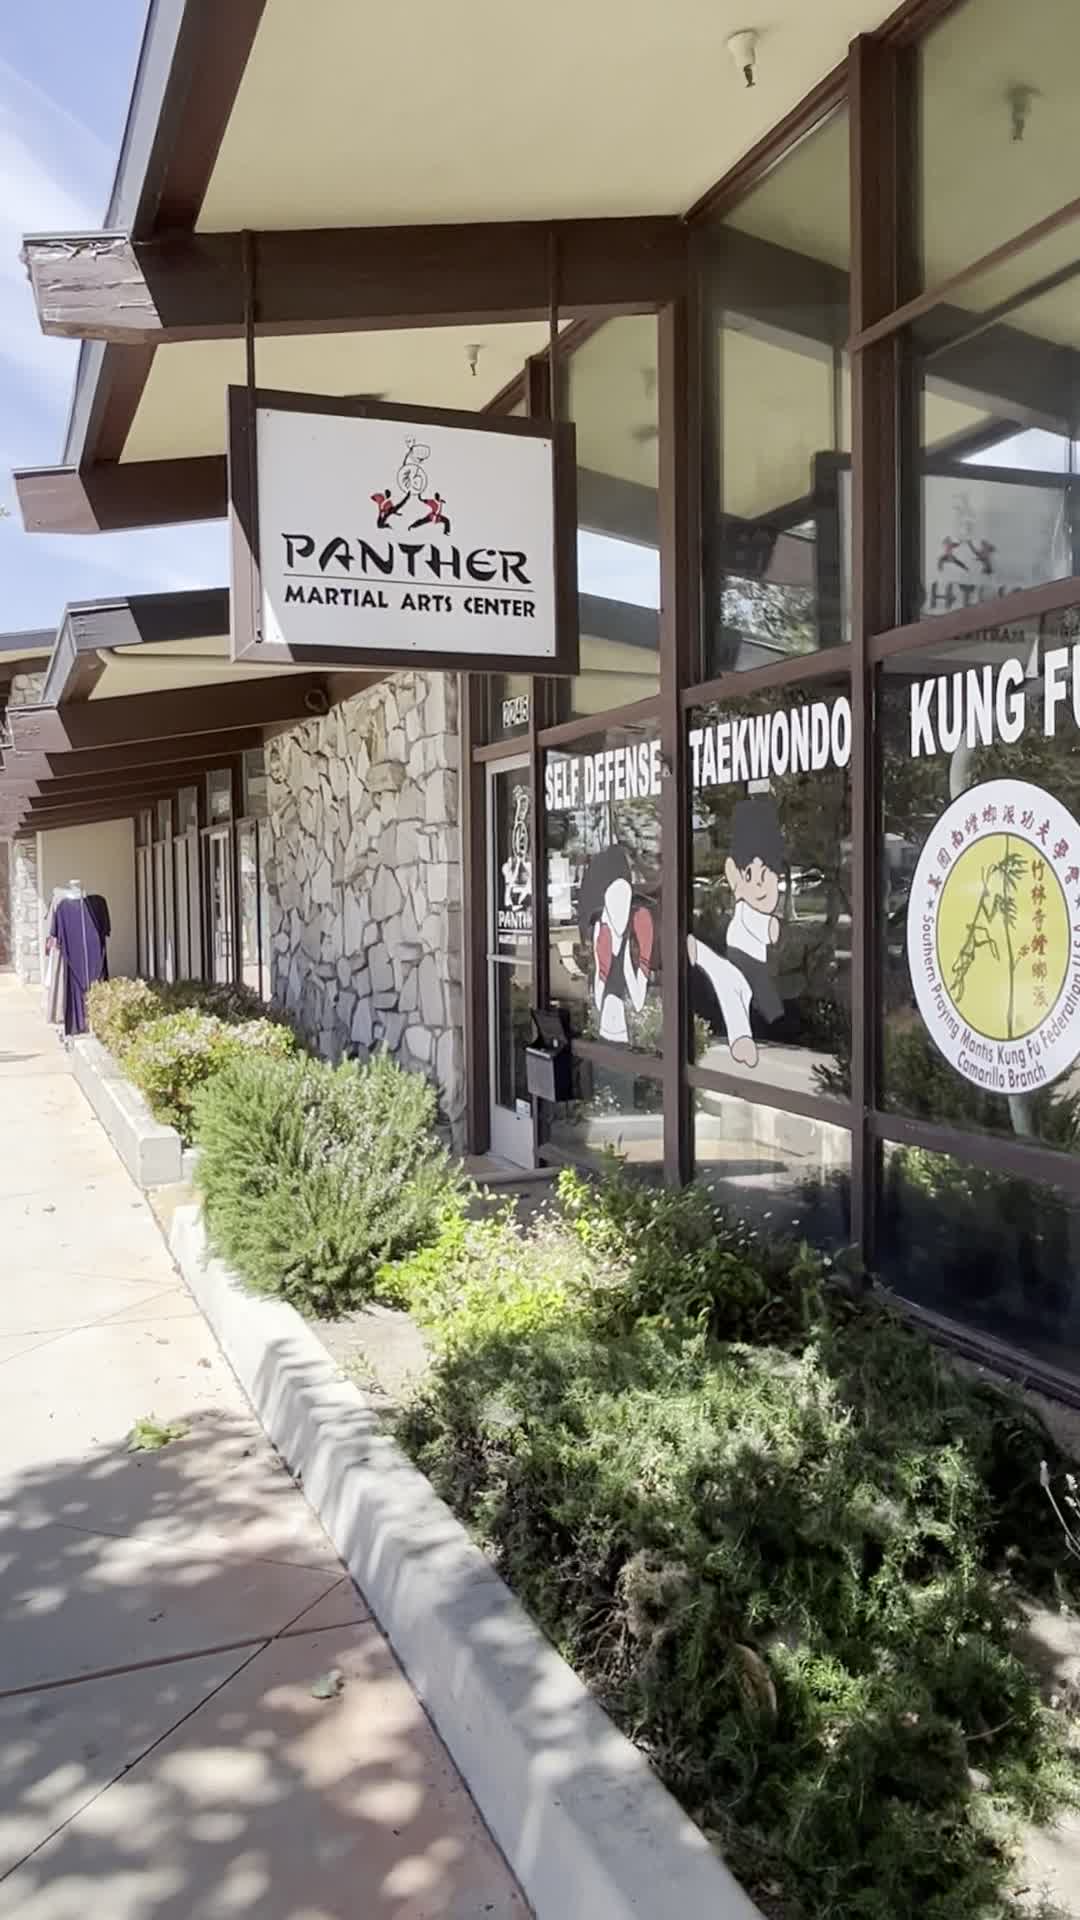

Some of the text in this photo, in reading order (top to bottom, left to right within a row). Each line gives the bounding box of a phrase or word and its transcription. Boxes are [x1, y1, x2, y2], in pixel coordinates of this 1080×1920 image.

[281, 533, 532, 584] PANTHER
[284, 586, 536, 618] MARTIAL ARTS CENTER
[911, 645, 1080, 757] KUNG F
[689, 696, 851, 787] TAEKWONDO
[545, 740, 662, 811] SELF DEFENSE
[499, 911, 532, 928] PANTH
[922, 914, 935, 983] Southern
[931, 983, 960, 1040] Praying
[960, 1029, 994, 1063] Mantis
[997, 1046, 1026, 1069] Kung
[1026, 1039, 1041, 1059] Fu
[957, 1051, 1047, 1088] Camarillo Branch
